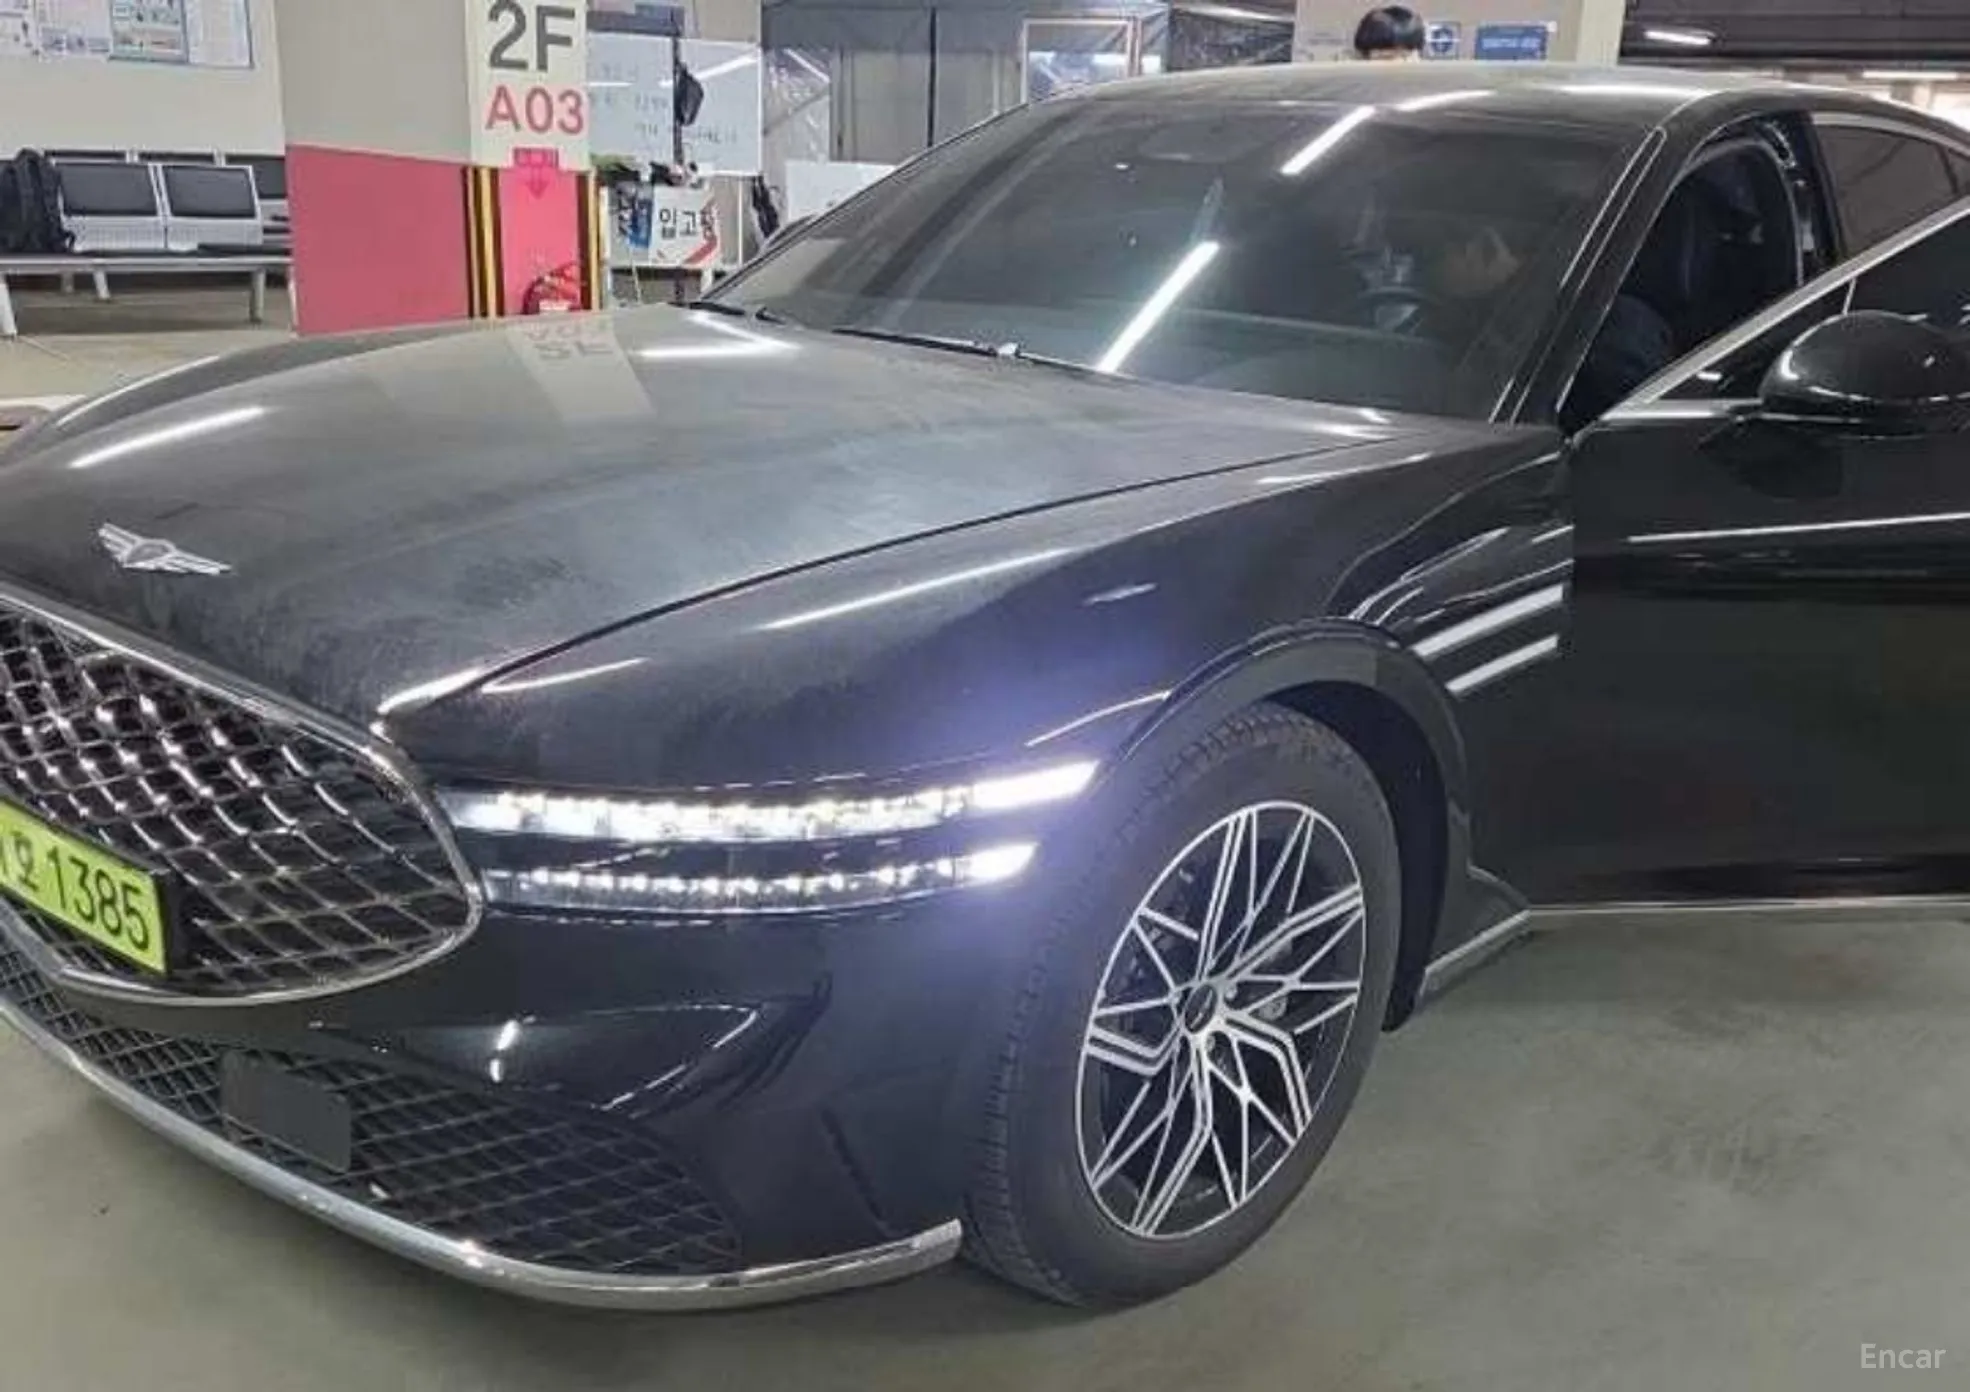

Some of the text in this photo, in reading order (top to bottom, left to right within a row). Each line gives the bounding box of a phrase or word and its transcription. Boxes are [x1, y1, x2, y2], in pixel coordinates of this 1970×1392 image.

[487, 0, 576, 71] 2F
[486, 84, 584, 135] A03
[46, 845, 149, 952] 1385
